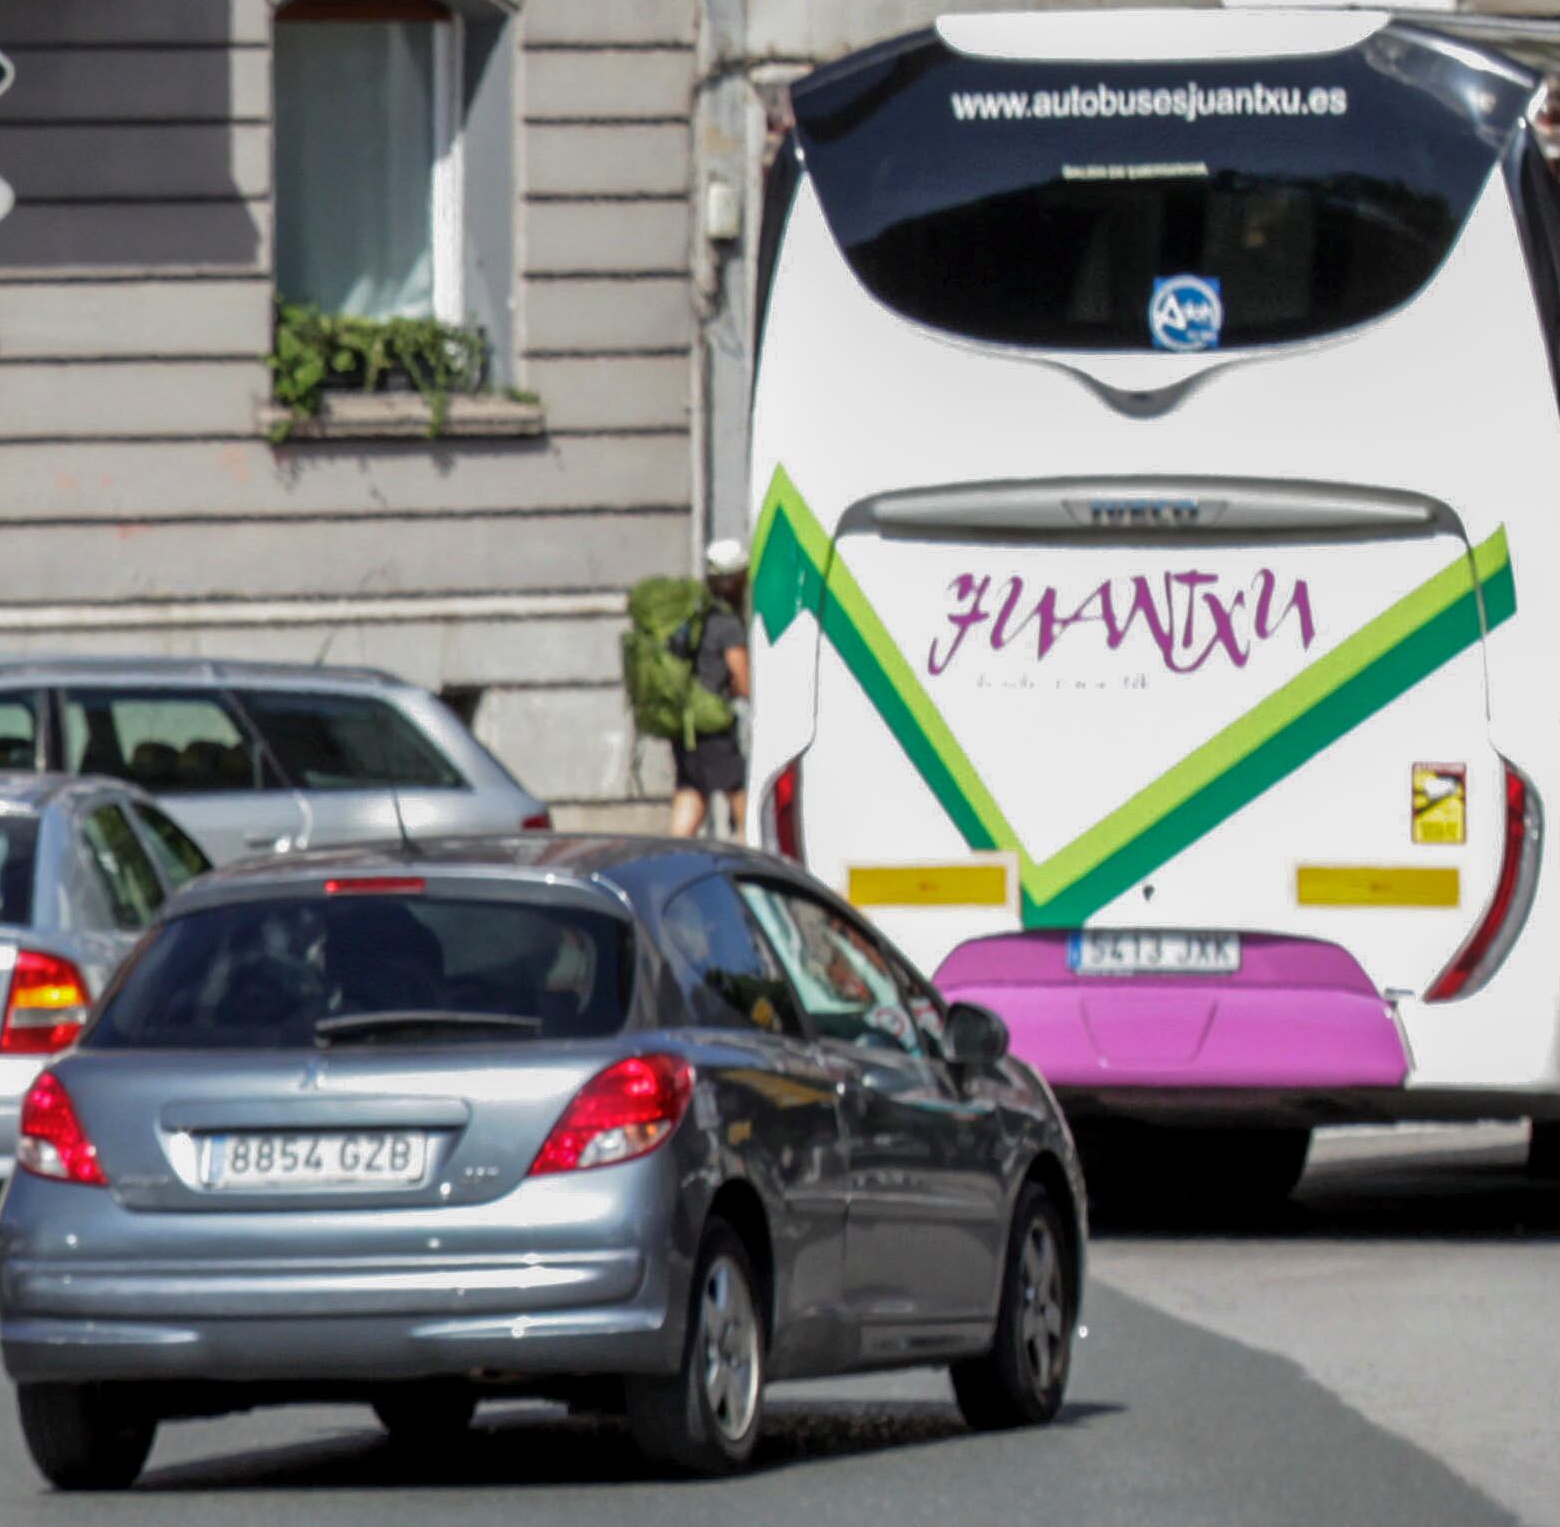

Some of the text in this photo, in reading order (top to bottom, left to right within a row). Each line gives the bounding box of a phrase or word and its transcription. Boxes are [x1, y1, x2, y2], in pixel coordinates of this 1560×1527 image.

[950, 82, 1347, 122] www.autobusesjuantxu.es
[230, 1135, 412, 1173] 8854 GZB
